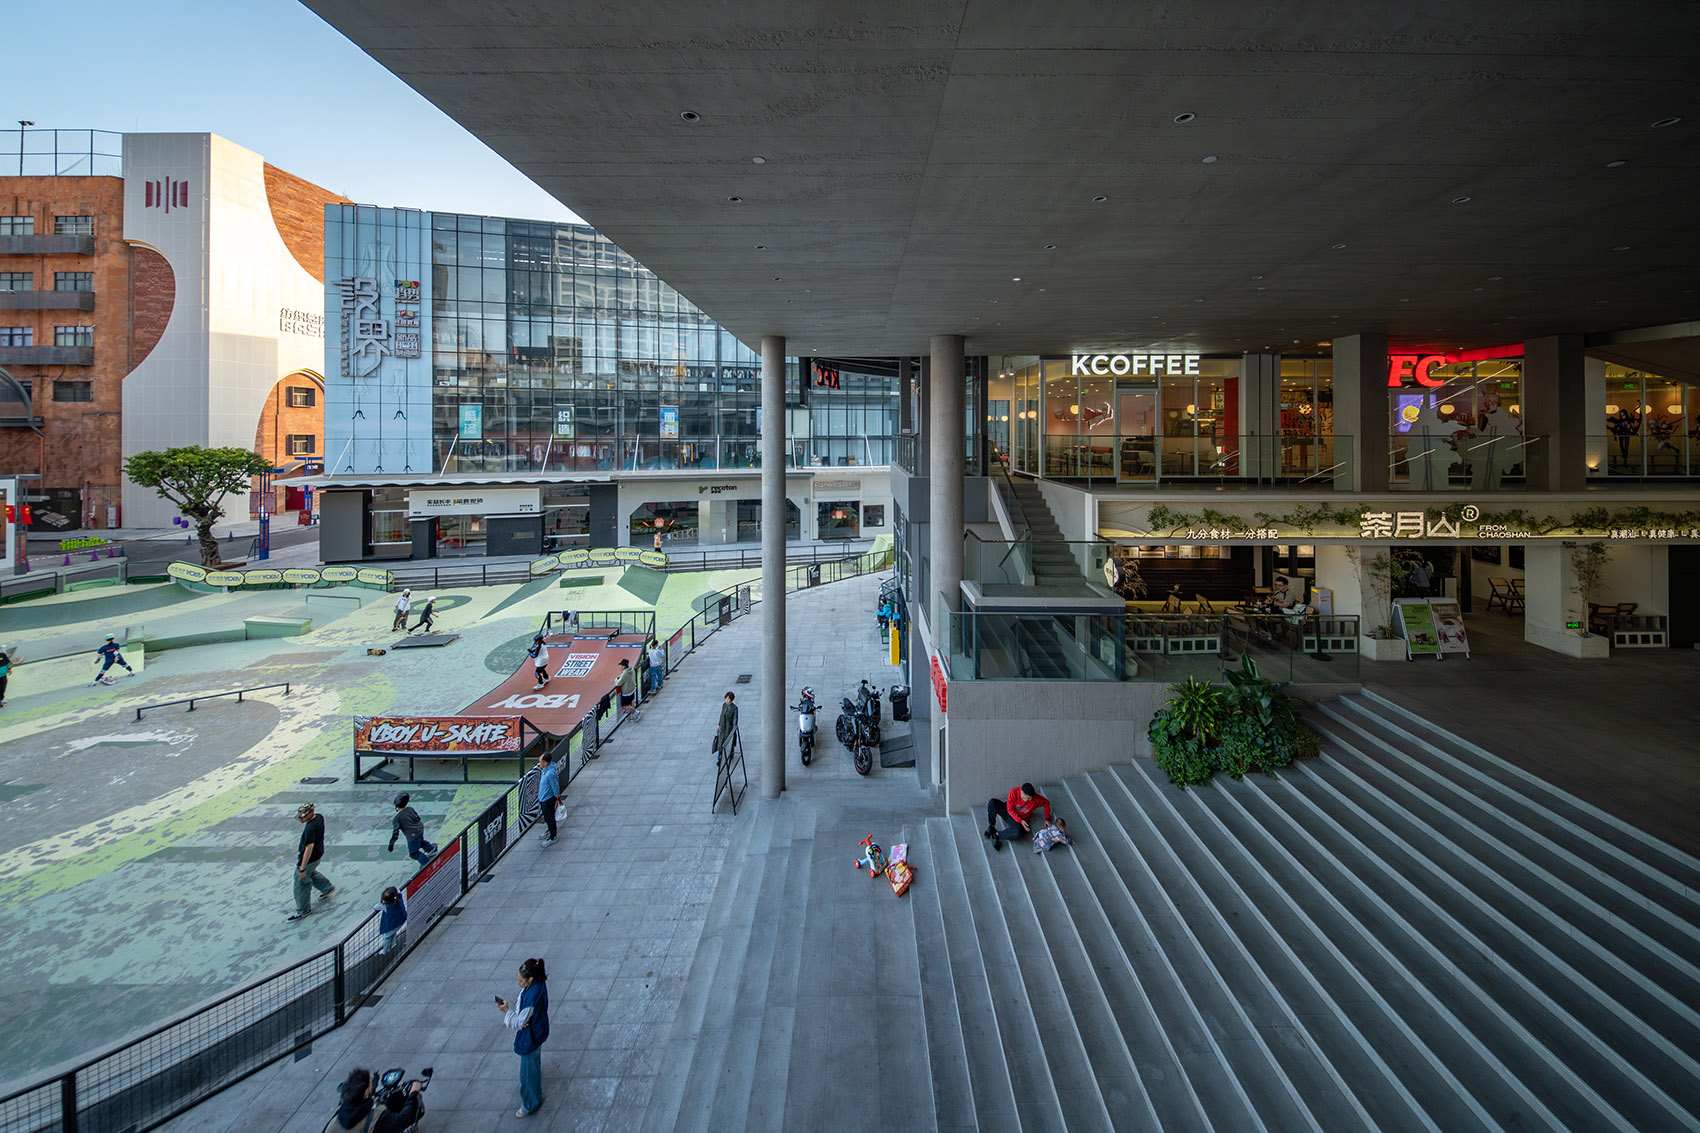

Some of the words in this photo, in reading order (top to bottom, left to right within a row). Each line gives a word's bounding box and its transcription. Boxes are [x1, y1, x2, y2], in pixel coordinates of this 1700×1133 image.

[1071, 355, 1200, 375] KCOFFEE
[1387, 355, 1446, 388] FC
[1186, 528, 1231, 539] 九分食材
[1234, 528, 1279, 539] 一分搭配
[1360, 511, 1461, 539] 茶月山
[560, 668, 588, 676] WEAR
[563, 660, 594, 668] STREET
[369, 722, 421, 744] VBOY
[421, 721, 511, 746] U-SKATE
